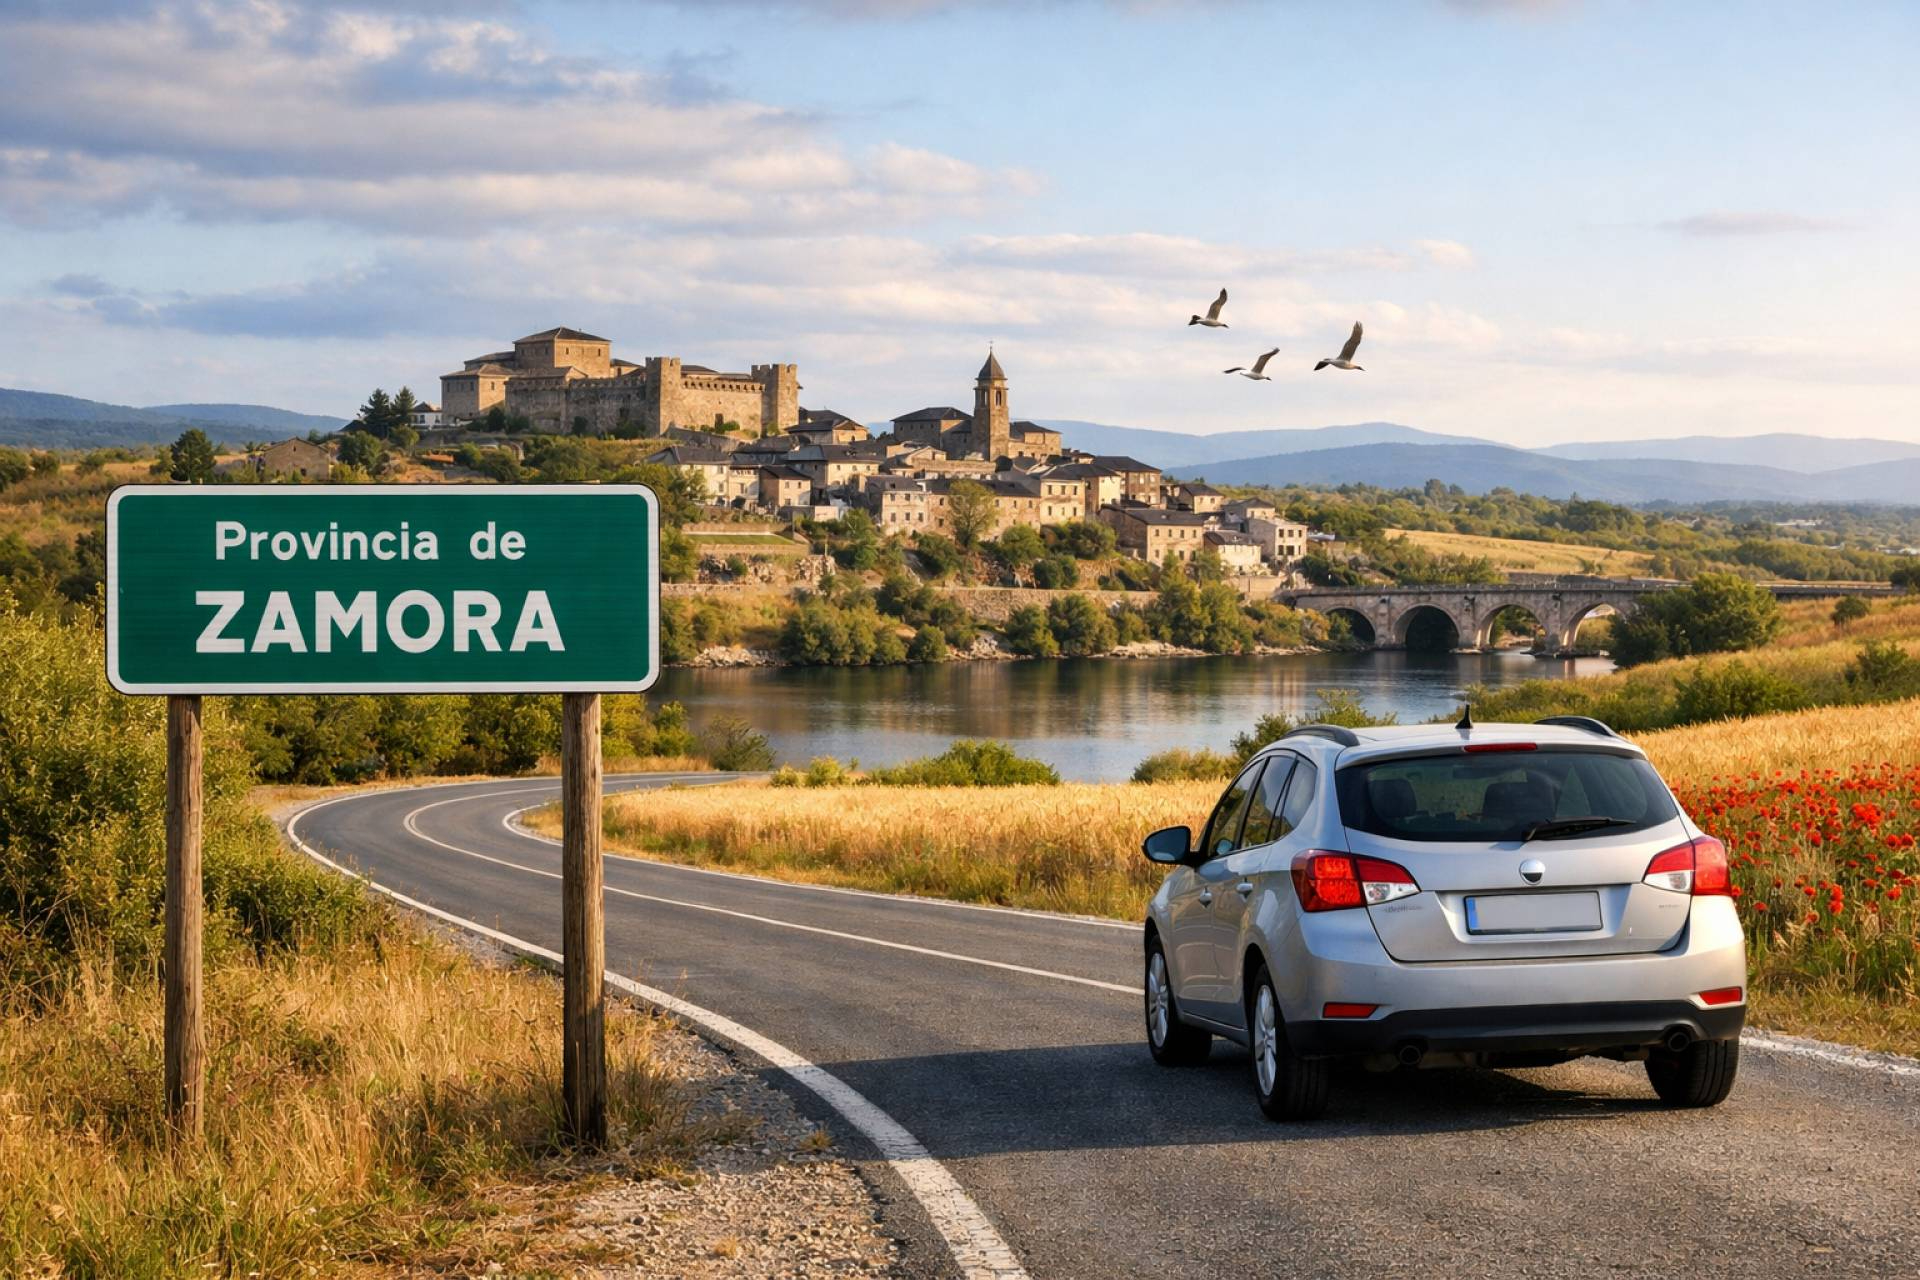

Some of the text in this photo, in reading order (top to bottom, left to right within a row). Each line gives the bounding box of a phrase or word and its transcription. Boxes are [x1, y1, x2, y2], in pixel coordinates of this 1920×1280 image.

[216, 522, 526, 560] Provincia de
[196, 591, 566, 653] ZAMORA
